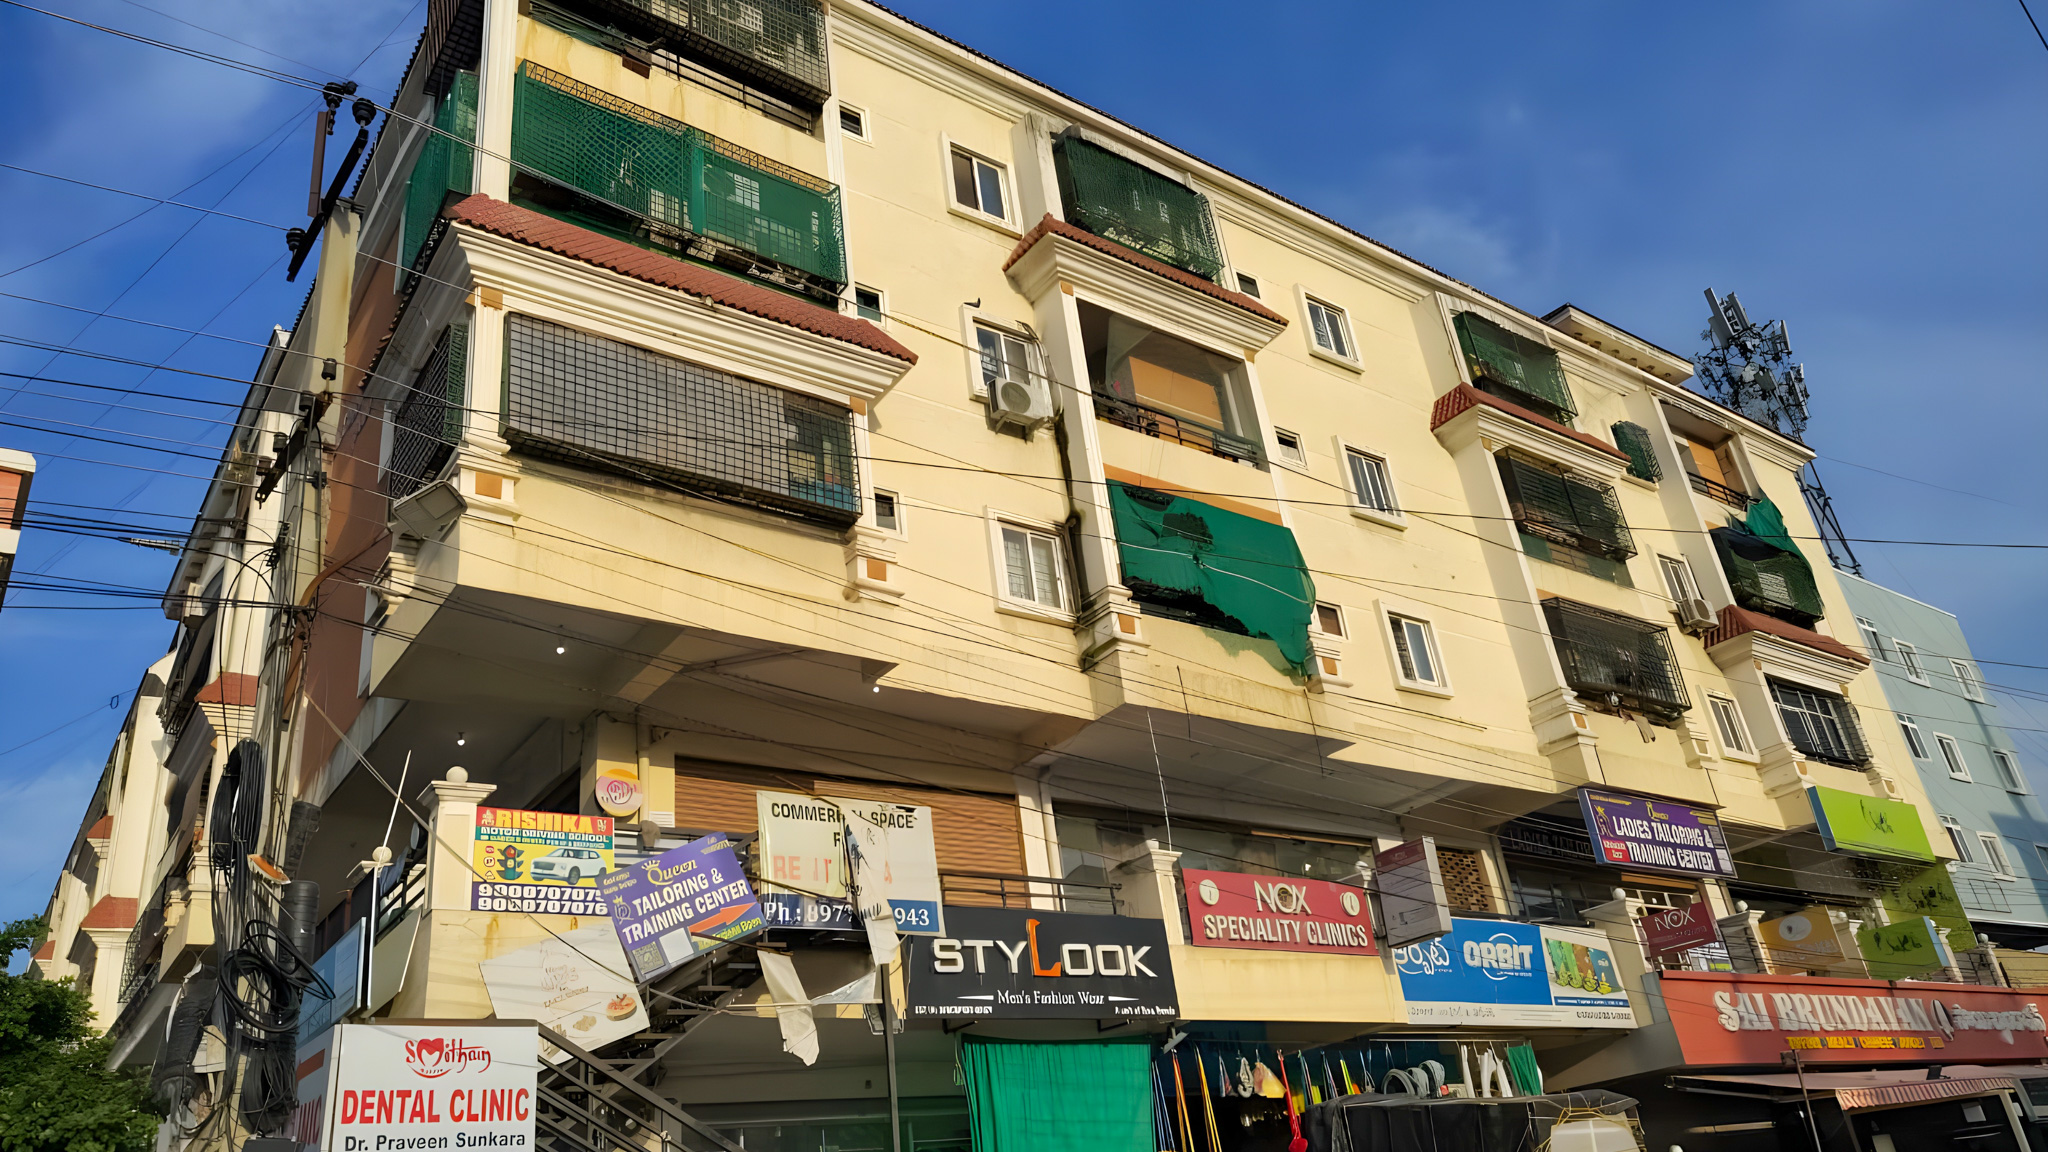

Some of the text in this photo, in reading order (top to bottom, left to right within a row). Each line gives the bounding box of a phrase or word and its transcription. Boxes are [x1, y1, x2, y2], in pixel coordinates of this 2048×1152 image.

[480, 826, 519, 837] MOTOR
[522, 829, 566, 840] DRIVING
[568, 832, 610, 843] SCHOOL
[495, 809, 593, 834] RISHIKA
[871, 811, 914, 829] SPACE
[1612, 815, 1715, 849] LADIES TAILORING &
[1625, 841, 1678, 868] TRAINING
[1676, 848, 1716, 872] CENTER
[647, 859, 698, 886] Queen
[477, 897, 608, 915] 9000707076
[631, 872, 709, 917] TAILORING
[710, 868, 725, 885] &
[1254, 880, 1312, 915] NOX
[621, 902, 695, 945] TRAINING
[695, 878, 750, 915] CENTER
[1654, 907, 1696, 932] NOX
[1203, 913, 1369, 948] SPECIALITY CLINICS
[1463, 940, 1533, 970] ORBIT
[1713, 988, 1775, 1032] SAI
[341, 1087, 530, 1124] DENTAL CLINIC
[345, 1131, 525, 1151] Dr. Praveen Sunkara
